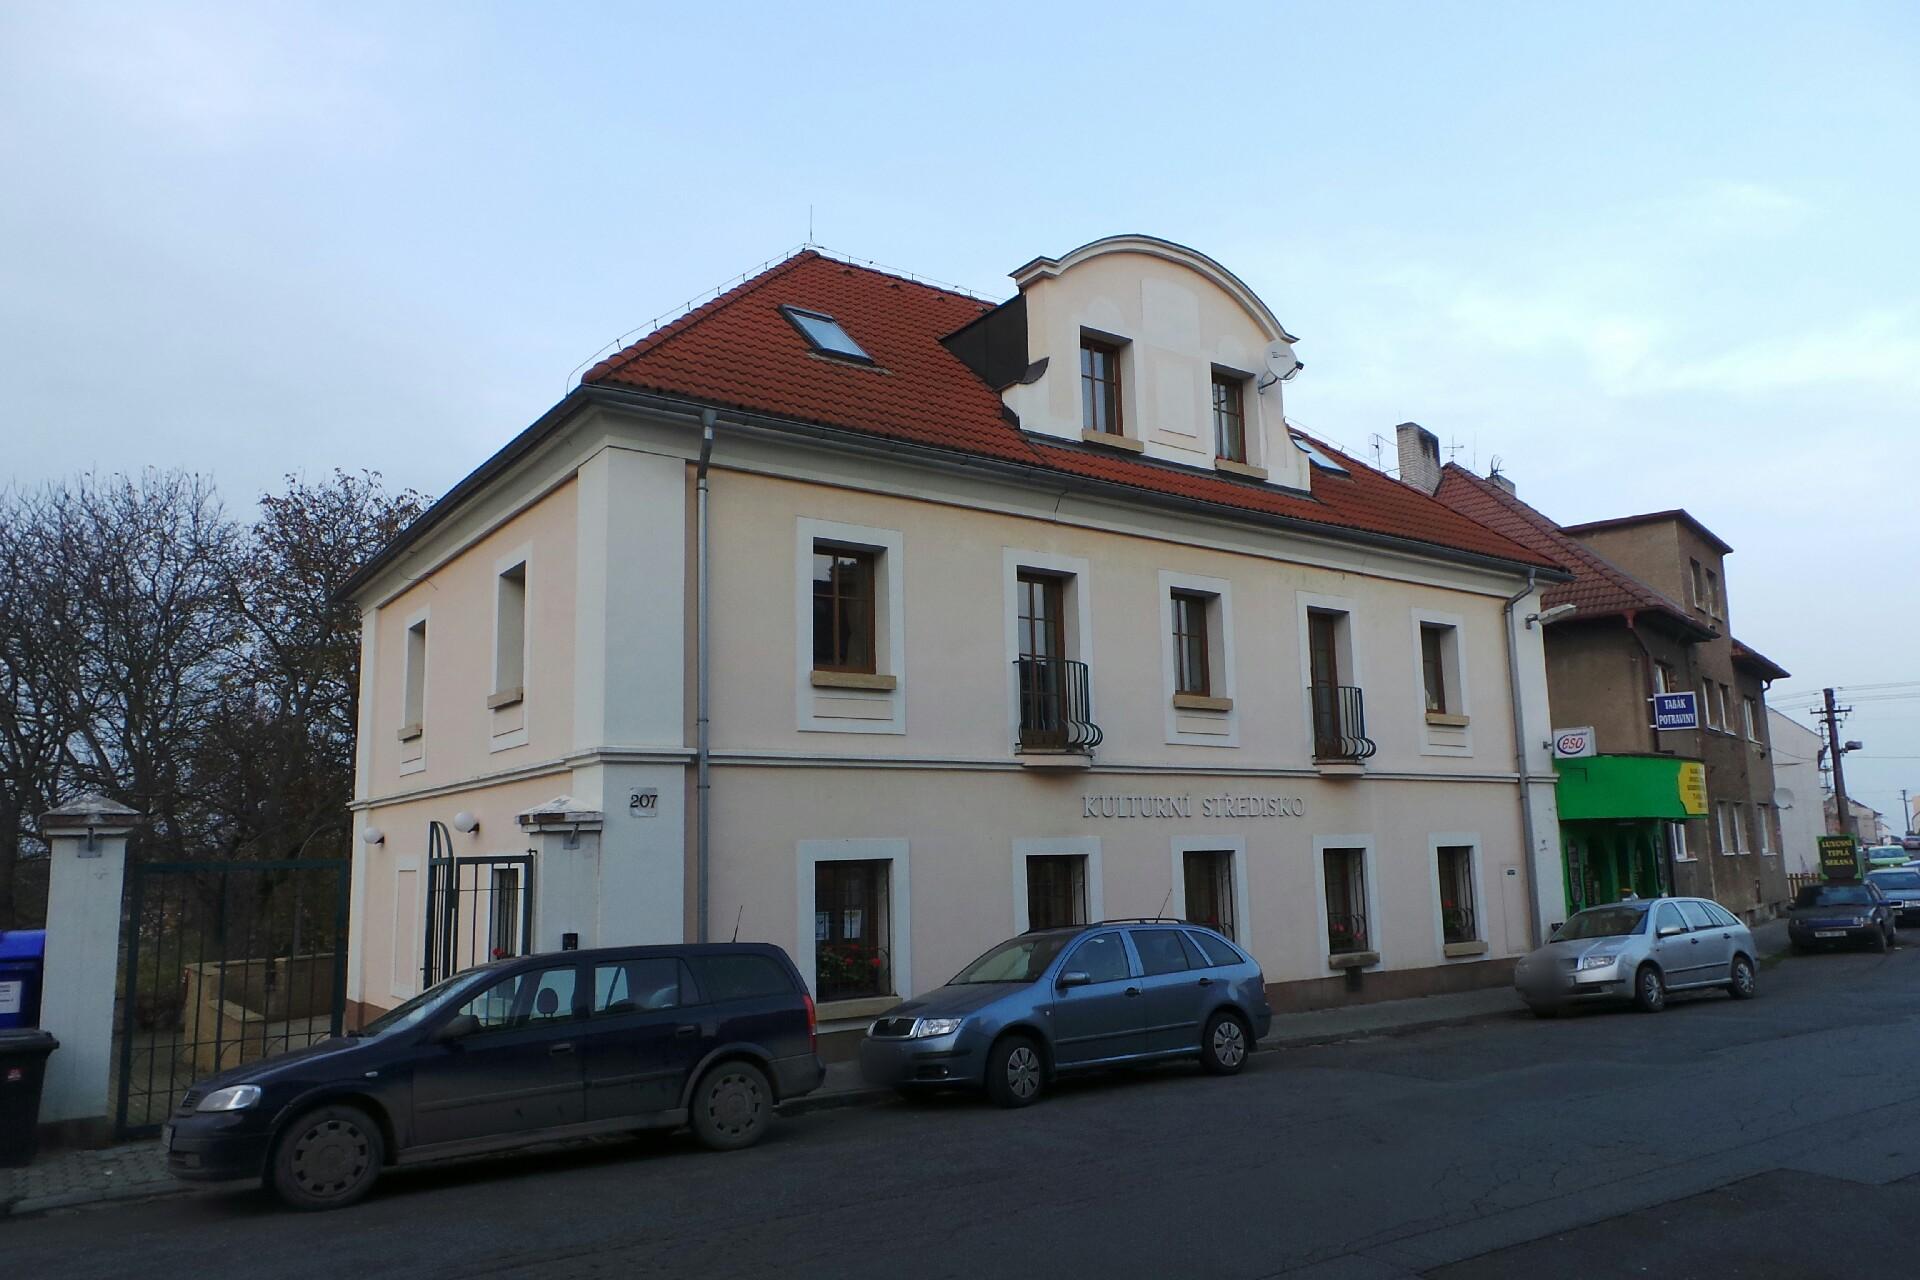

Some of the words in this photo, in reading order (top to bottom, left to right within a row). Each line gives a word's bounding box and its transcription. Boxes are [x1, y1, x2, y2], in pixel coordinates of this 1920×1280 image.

[1664, 695, 1686, 709] TABÁK
[1658, 713, 1694, 725] POTRAVINY
[630, 794, 658, 808] 207
[1082, 792, 1192, 818] KULTURNÍ
[1202, 792, 1305, 818] STŘEDISKO
